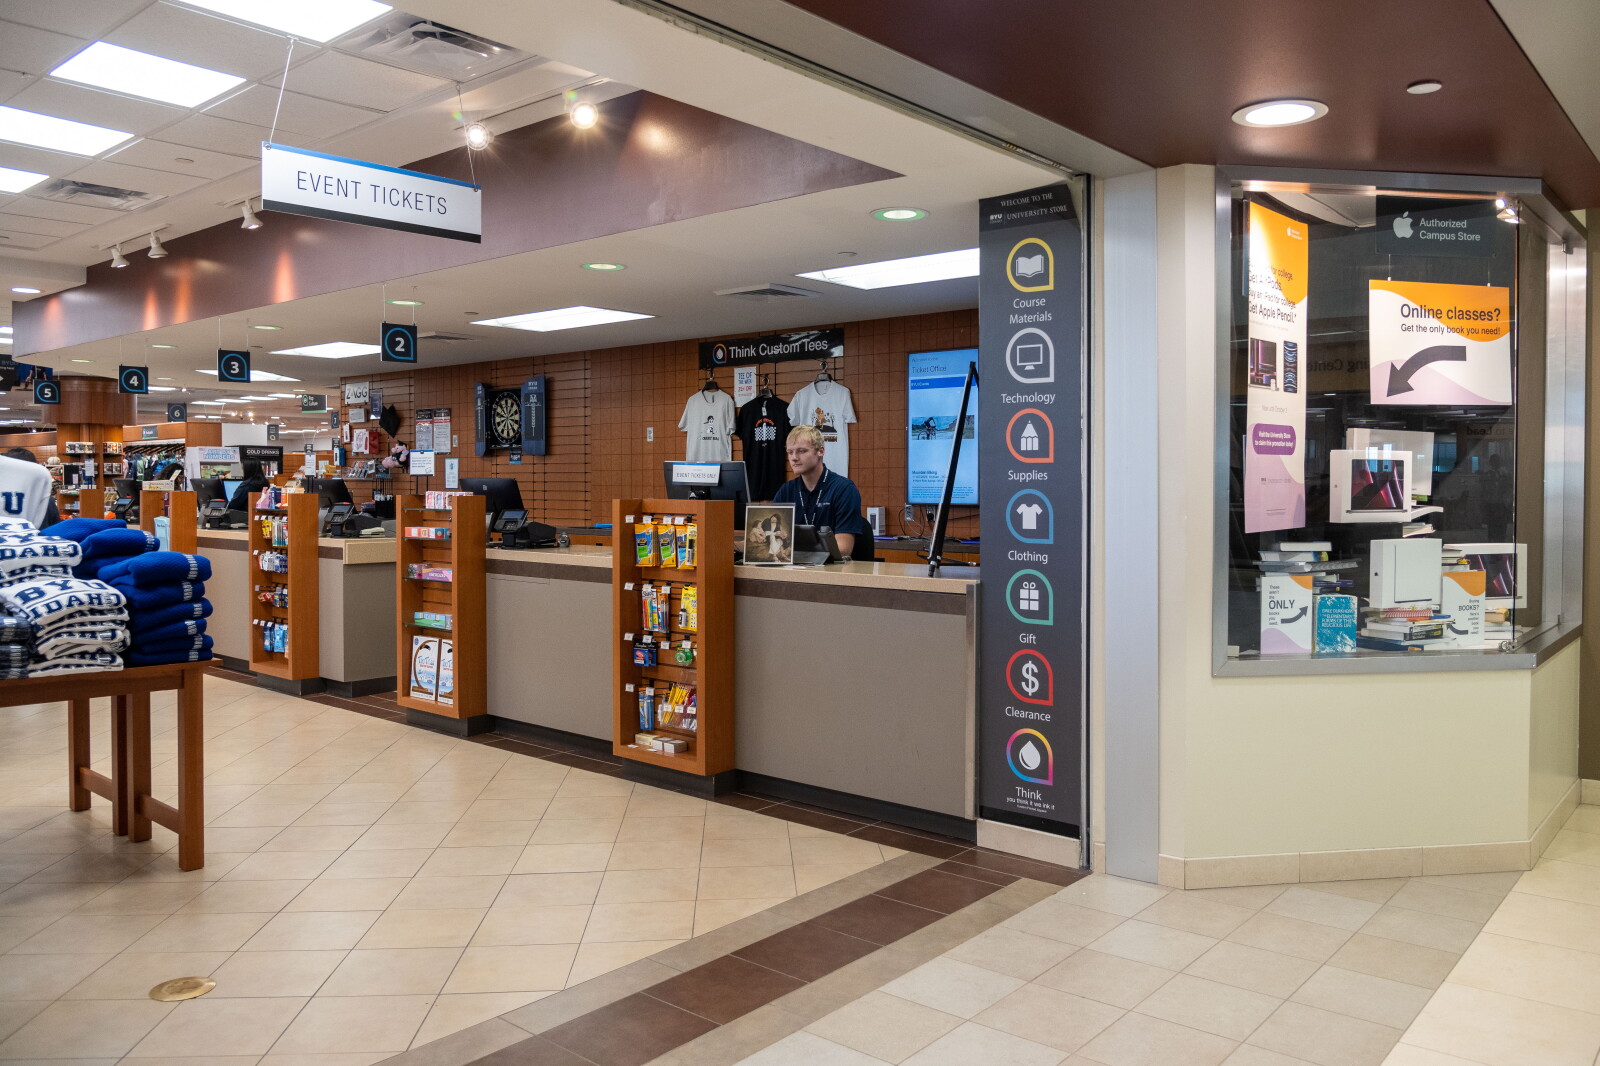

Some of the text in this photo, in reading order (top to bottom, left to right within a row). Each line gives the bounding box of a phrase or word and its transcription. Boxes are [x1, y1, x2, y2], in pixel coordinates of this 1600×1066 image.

[296, 170, 447, 215] EVENT TICKETS
[1000, 197, 1030, 207] WELCOME
[1031, 195, 1041, 203] TO
[1007, 209, 1048, 220] UNIVERSITY
[1049, 205, 1068, 213] STORE
[1419, 217, 1467, 228] Authorized
[1419, 230, 1481, 241] Campus Store
[1013, 298, 1046, 309] Course
[1009, 311, 1052, 325] Materials
[1259, 303, 1275, 320] Apple
[1400, 303, 1501, 321] Online classes?
[1400, 323, 1501, 336] Get the only book you need!
[394, 337, 406, 352] 2
[728, 339, 829, 358] Think Custom Tees
[230, 361, 240, 374] 3
[911, 365, 947, 374] Ticket Office
[129, 375, 139, 387] 4
[43, 388, 52, 398] 5
[1000, 391, 1056, 405] Technology
[174, 409, 181, 418] 6
[1008, 469, 1048, 483] Supplies
[0, 542, 79, 561] DAHO
[1007, 550, 1048, 564] Clothing
[1268, 599, 1296, 610] ONLY
[1019, 633, 1037, 645] Gift
[1005, 706, 1051, 722] Clearance
[1015, 786, 1042, 801] Think
[1016, 797, 1029, 805] think
